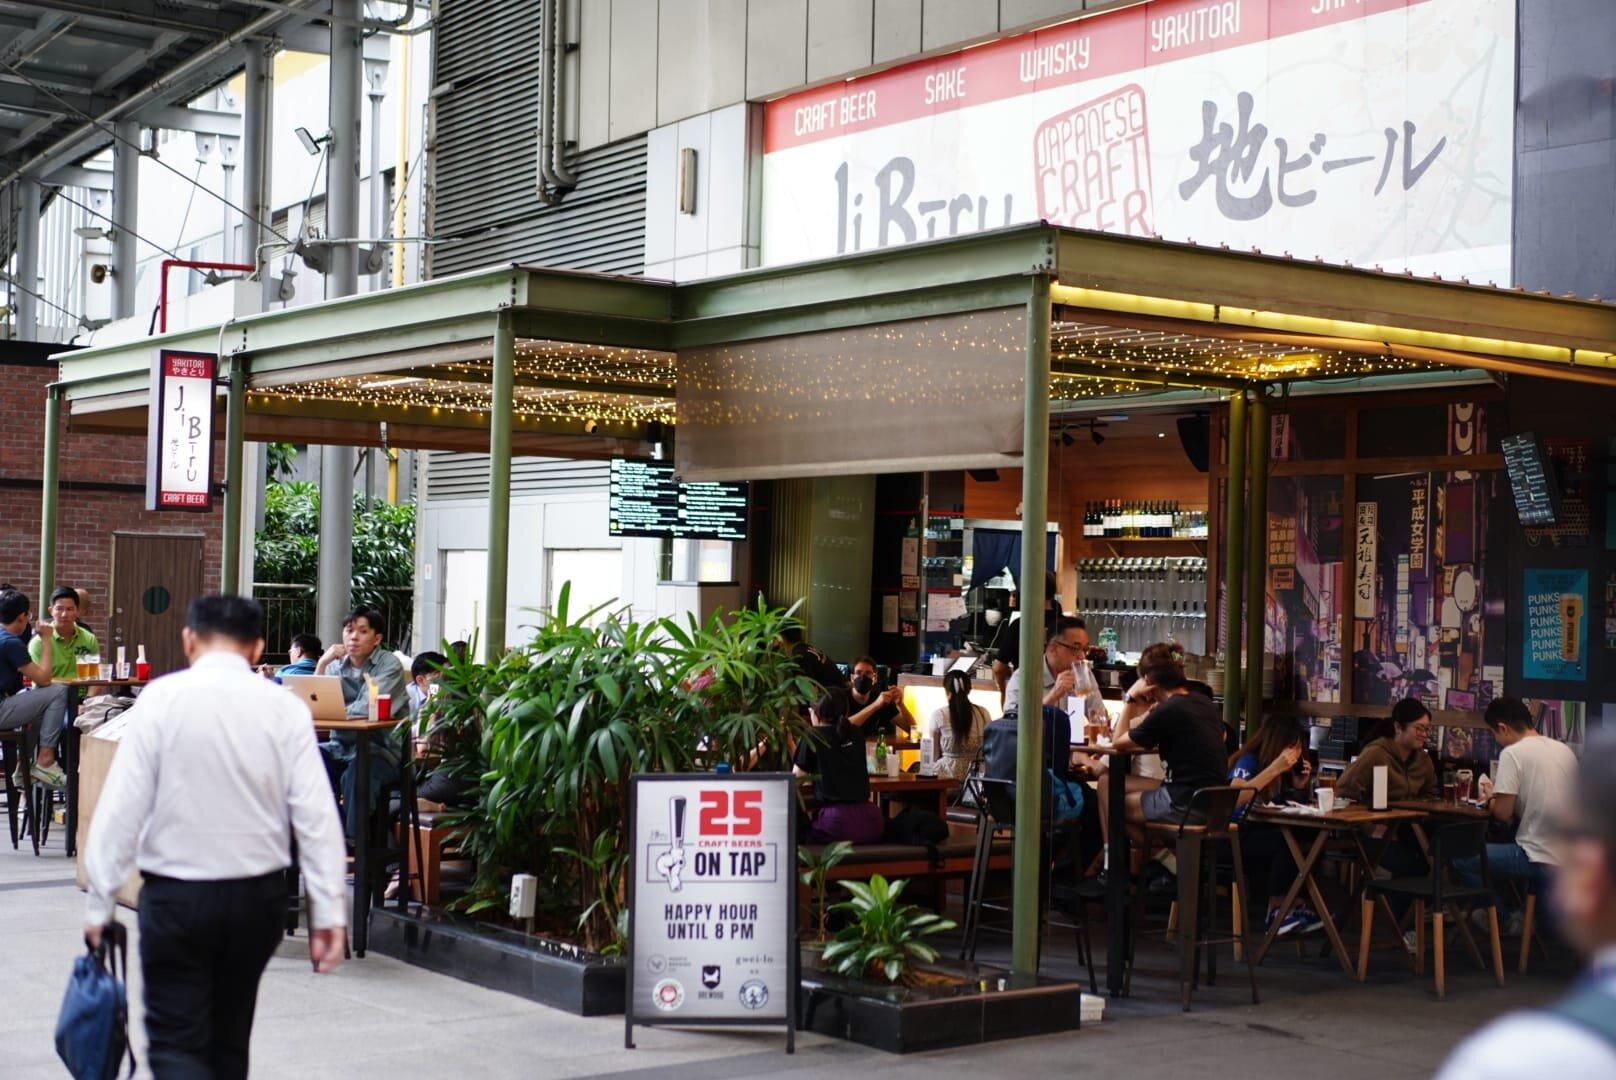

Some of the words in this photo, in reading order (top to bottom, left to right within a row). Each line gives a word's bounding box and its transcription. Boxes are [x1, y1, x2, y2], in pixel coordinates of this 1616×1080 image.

[1151, 0, 1240, 52] YAKITORI
[1019, 36, 1090, 83] WHISKY
[925, 67, 966, 105] SAKE
[795, 99, 837, 136] CRAFT
[840, 90, 877, 125] BEER
[1040, 92, 1144, 169] JAPANESE
[1180, 92, 1447, 221] 地ビール
[1042, 133, 1145, 218] CRAFT
[172, 359, 205, 368] YAKITORI
[172, 367, 205, 377] やきとり
[163, 493, 185, 503] CRAFT
[187, 494, 205, 504] BEER
[1528, 592, 1560, 605] PUNKS
[1529, 603, 1561, 616] PUNKS
[1530, 615, 1562, 628] PUNKS
[1531, 627, 1562, 639] PUNKS
[1532, 638, 1562, 650] PUNKS
[700, 790, 762, 835] 25
[699, 840, 728, 848] CRAFT
[731, 840, 762, 848] BEERS
[695, 852, 720, 876] ON
[729, 852, 766, 876] TAP
[665, 904, 712, 920] HAPPY
[719, 904, 758, 920] HOUR
[668, 923, 708, 940] UNTIL
[715, 923, 724, 940] 8
[731, 923, 754, 940] PM
